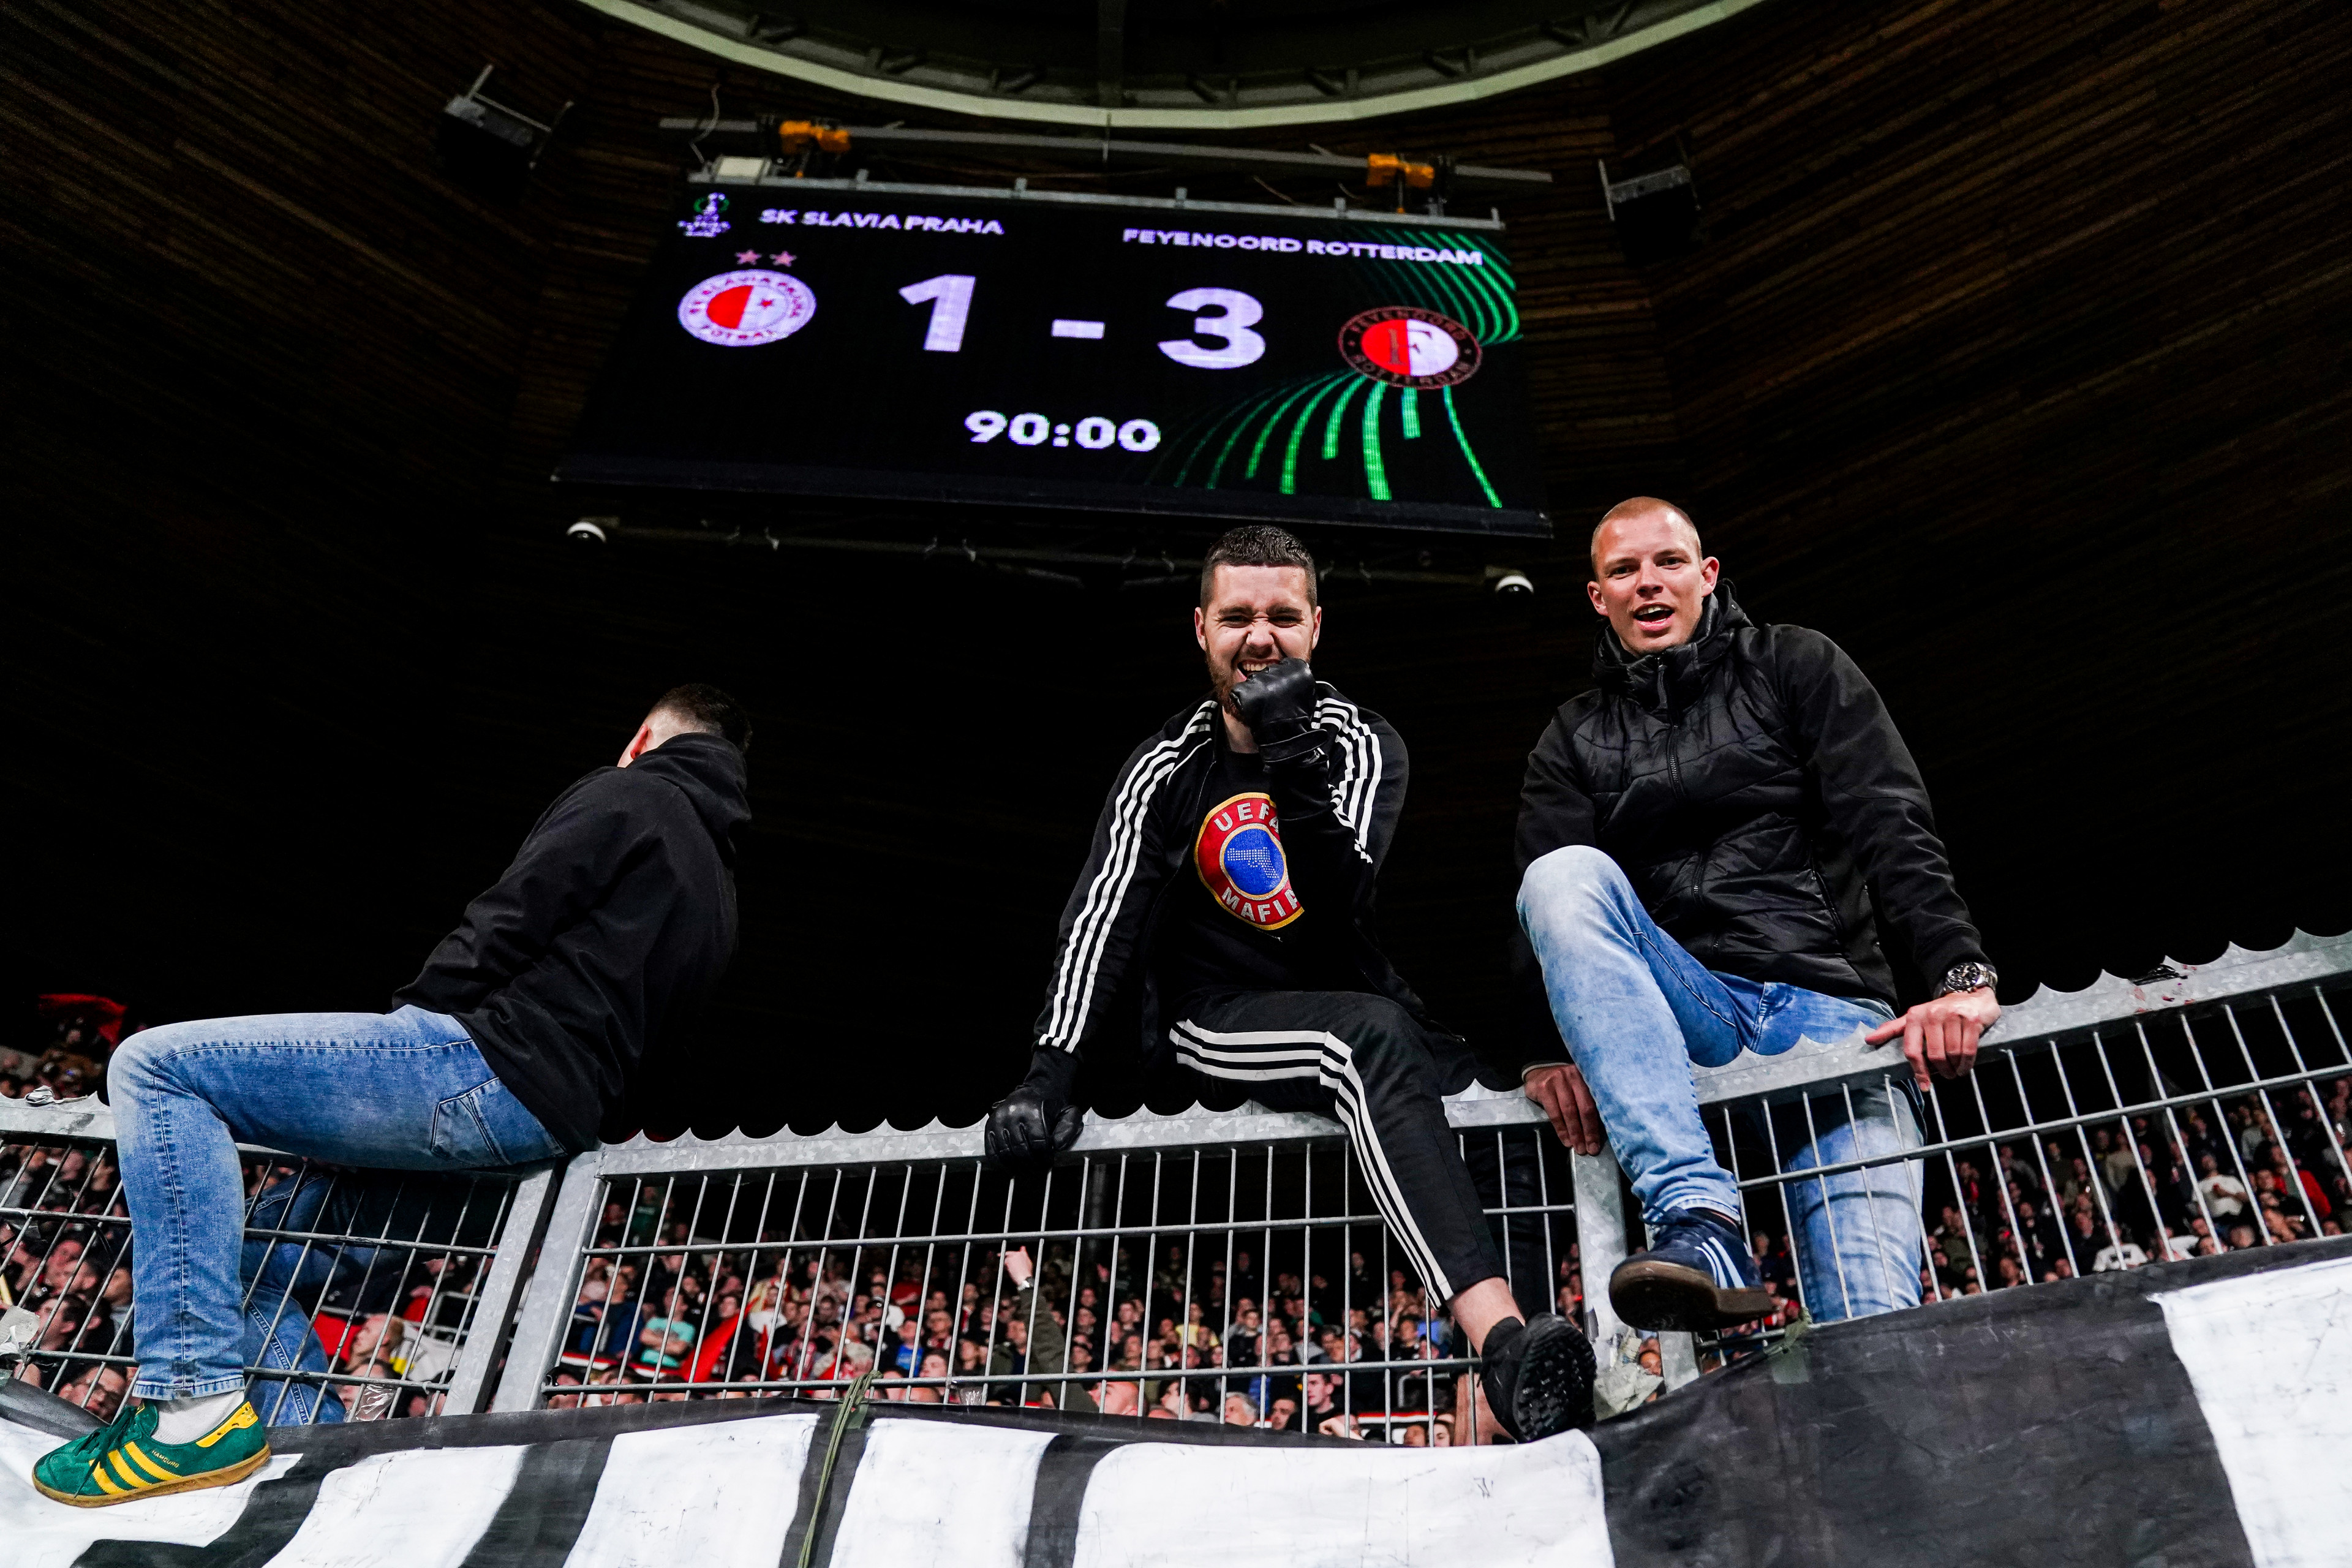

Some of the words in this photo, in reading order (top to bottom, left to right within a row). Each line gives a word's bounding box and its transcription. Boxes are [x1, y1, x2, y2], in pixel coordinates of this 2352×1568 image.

[759, 208, 798, 224] SK
[801, 211, 902, 230] SLAVIA
[903, 215, 1005, 235] PRAHA
[1123, 228, 1303, 252] FEYENOORD
[1306, 239, 1484, 266] ROTTERDAM
[899, 274, 976, 352] 1
[1157, 287, 1266, 370] 3
[963, 410, 1162, 453] 90:00
[1221, 886, 1298, 922] MAFIA
